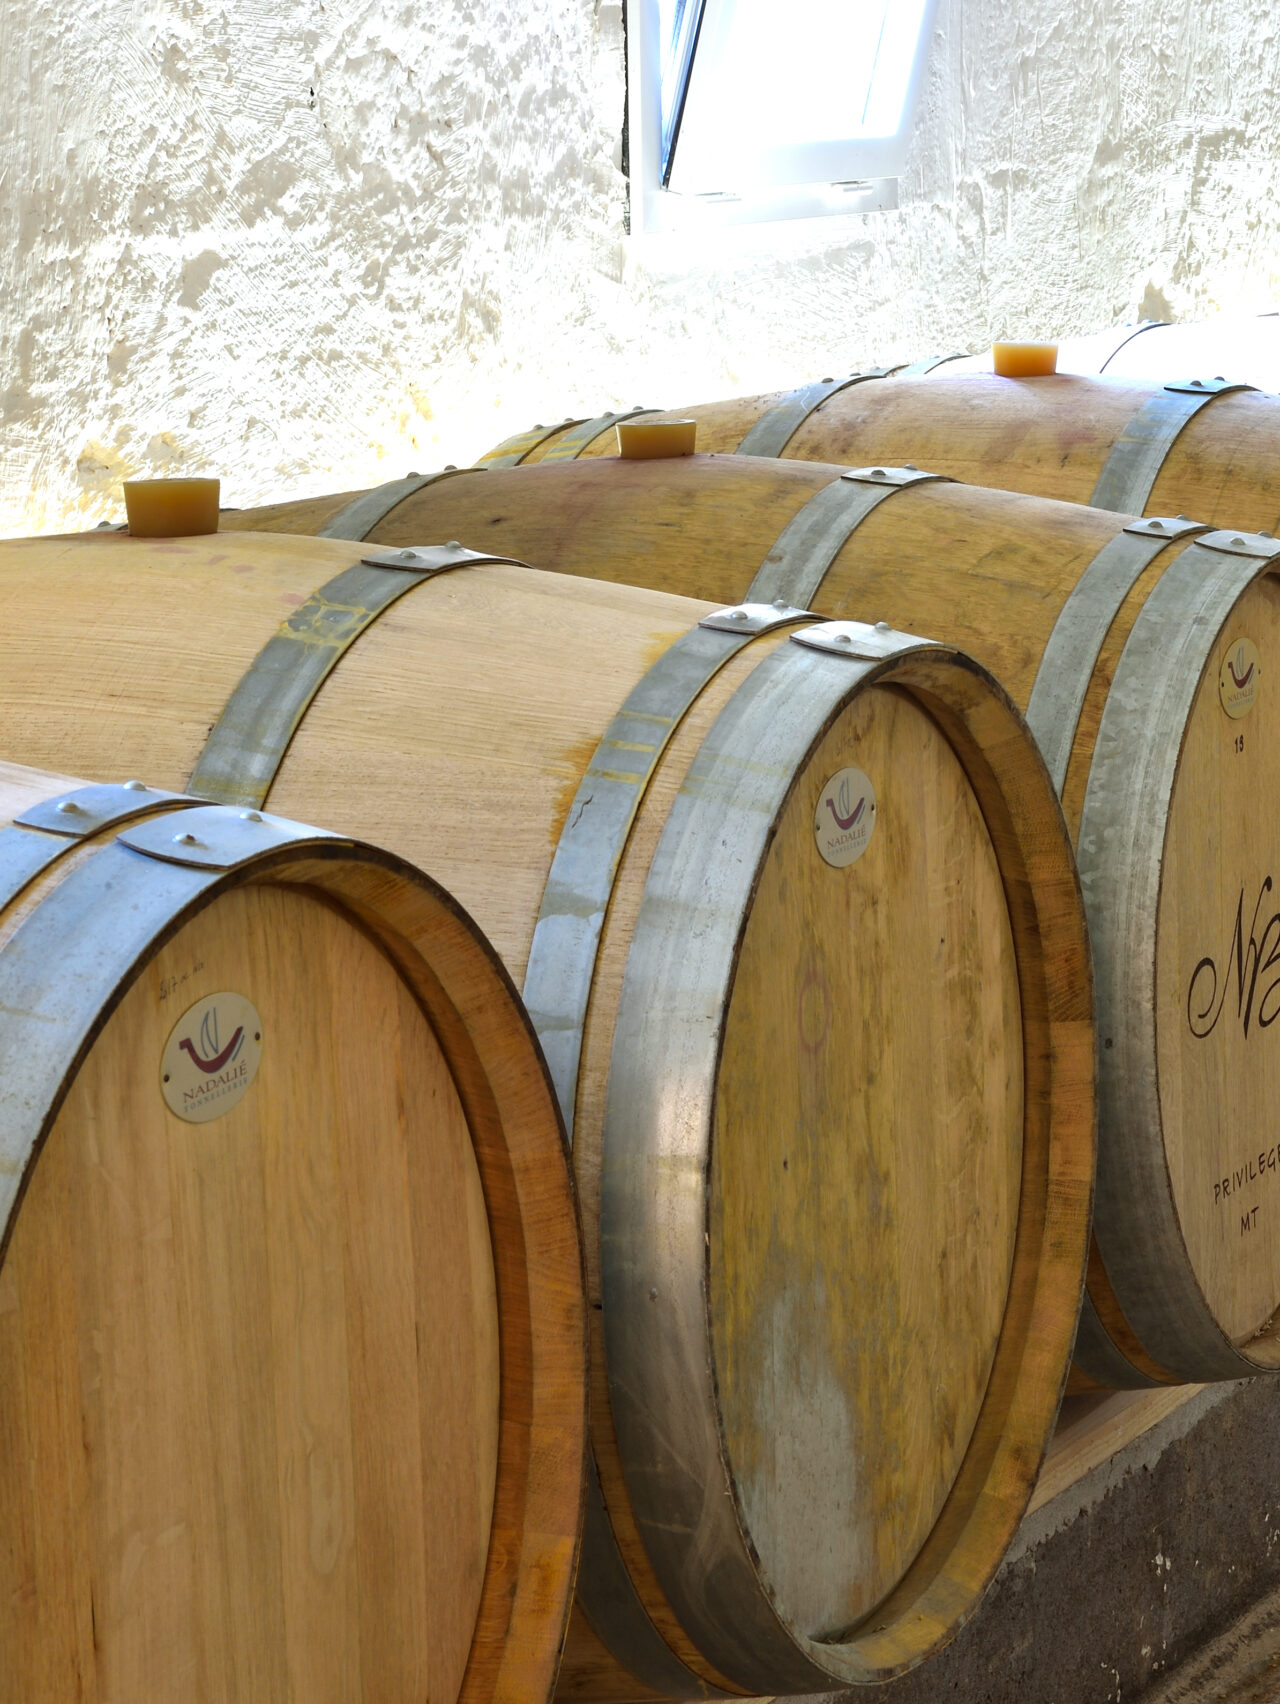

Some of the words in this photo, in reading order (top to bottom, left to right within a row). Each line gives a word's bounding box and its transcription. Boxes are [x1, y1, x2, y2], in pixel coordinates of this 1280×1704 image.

[183, 1059, 248, 1103] NADALIÉ
[184, 1077, 248, 1113] TONNELLERIE
[1240, 1206, 1260, 1237] MT
